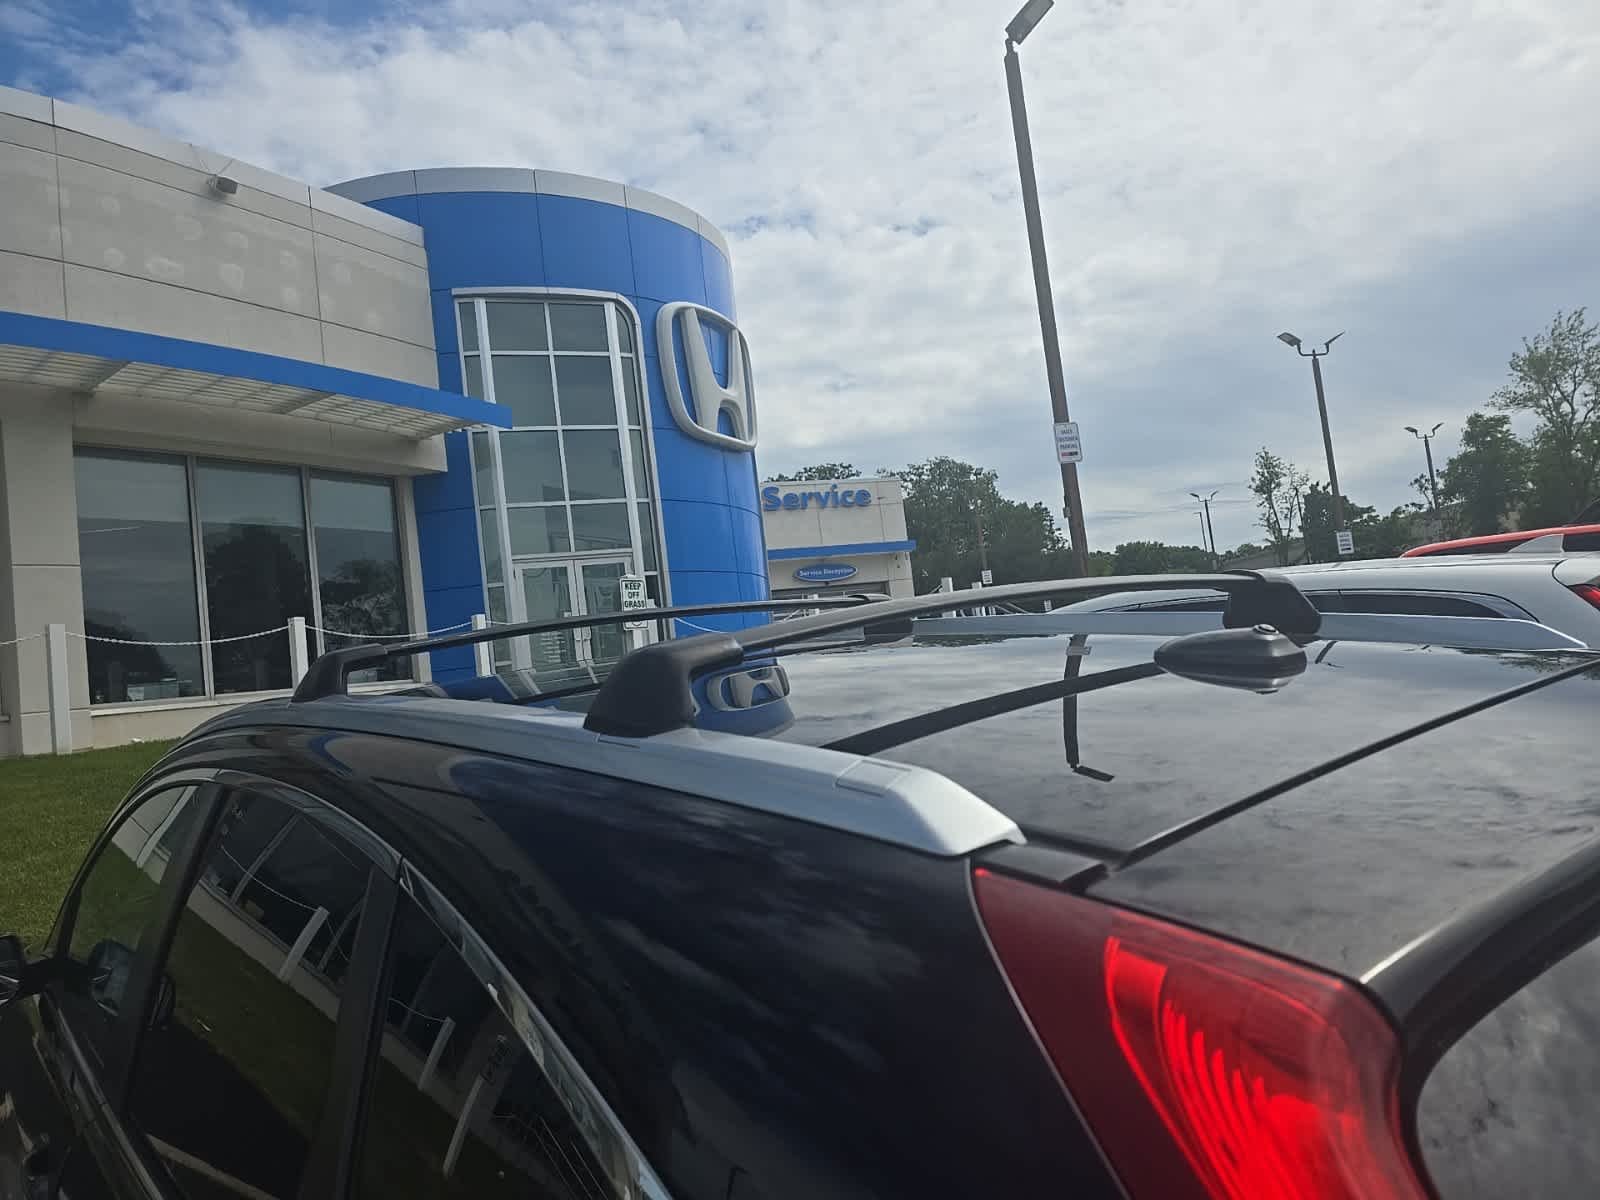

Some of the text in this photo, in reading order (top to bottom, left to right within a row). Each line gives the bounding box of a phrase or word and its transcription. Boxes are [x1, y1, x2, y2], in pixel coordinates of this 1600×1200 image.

[763, 484, 871, 512] Service
[624, 582, 641, 590] KEEP
[628, 591, 640, 599] OFF
[624, 600, 645, 609] GRASS
